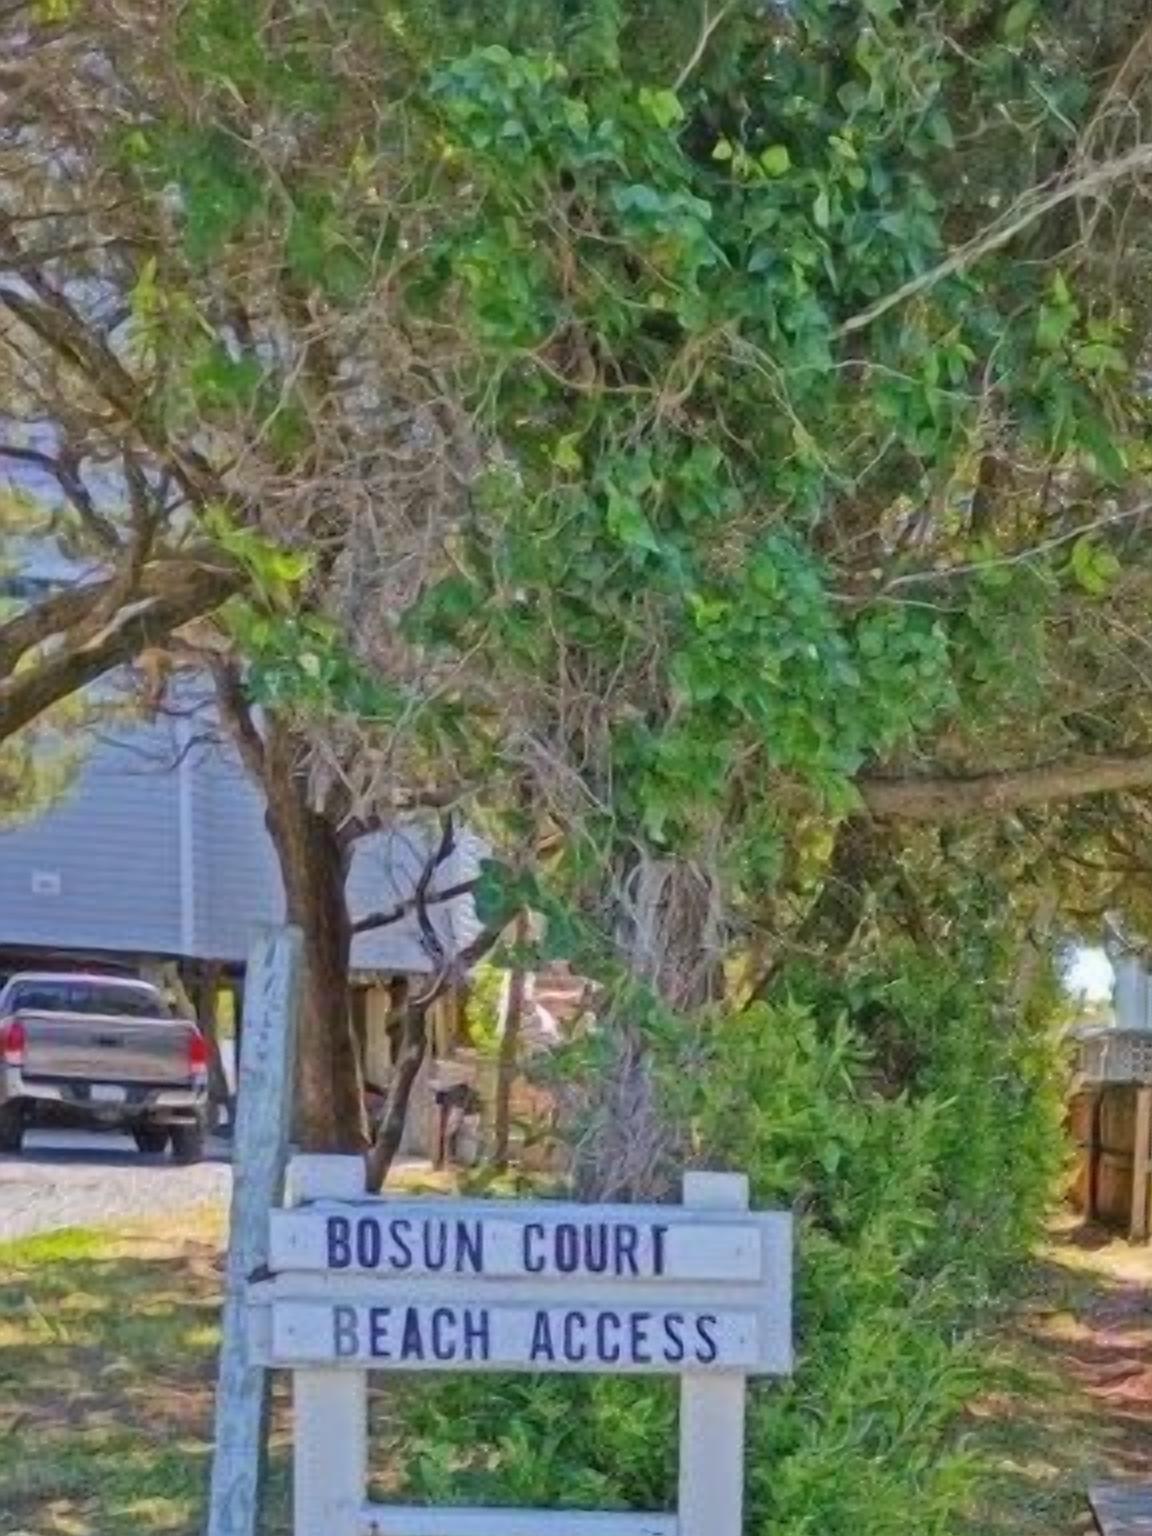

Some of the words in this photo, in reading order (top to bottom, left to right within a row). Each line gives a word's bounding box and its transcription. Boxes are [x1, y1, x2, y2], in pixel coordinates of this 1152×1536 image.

[326, 1216, 484, 1273] BOSUN
[523, 1221, 669, 1277] COURT
[332, 1306, 490, 1361] BEACH
[530, 1310, 719, 1364] ACCESS
